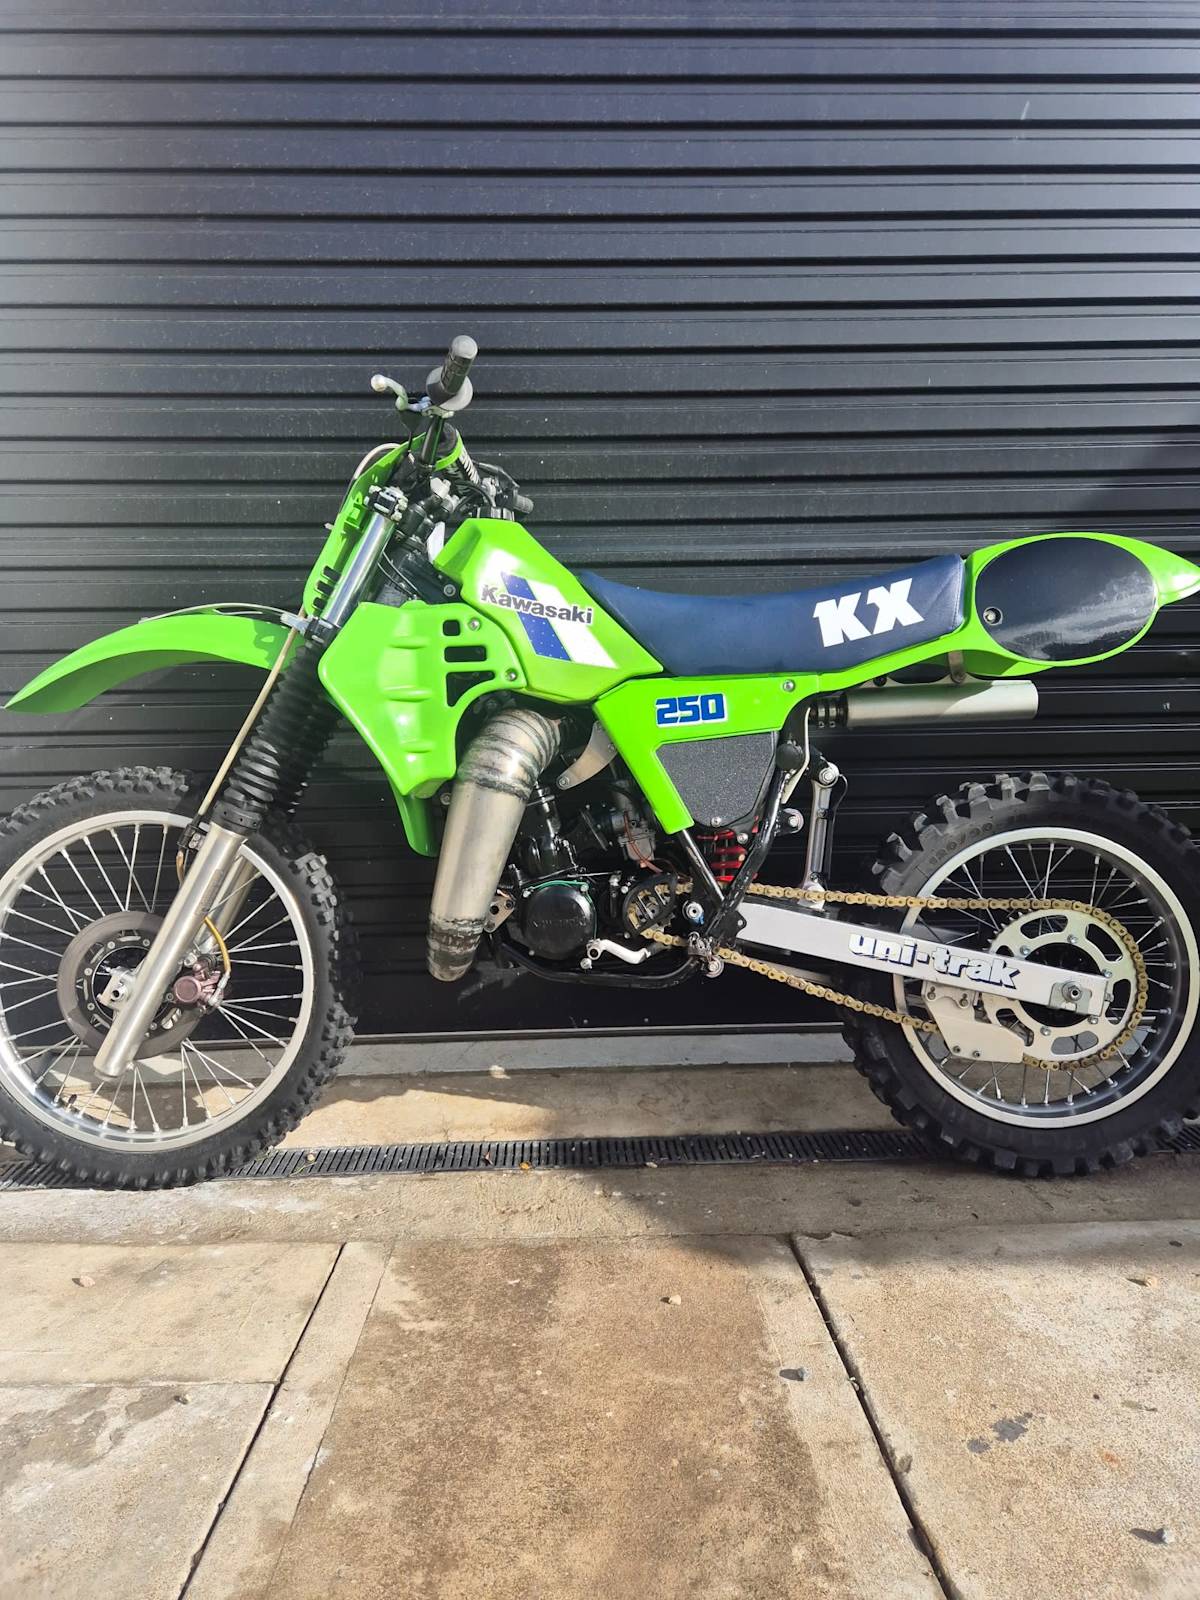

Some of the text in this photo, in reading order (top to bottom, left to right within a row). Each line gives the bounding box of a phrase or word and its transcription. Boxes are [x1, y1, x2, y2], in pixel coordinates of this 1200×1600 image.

[480, 584, 593, 624] Kawasaki
[813, 578, 924, 647] KX
[655, 693, 726, 726] 250
[848, 933, 1020, 989] uni-trak
